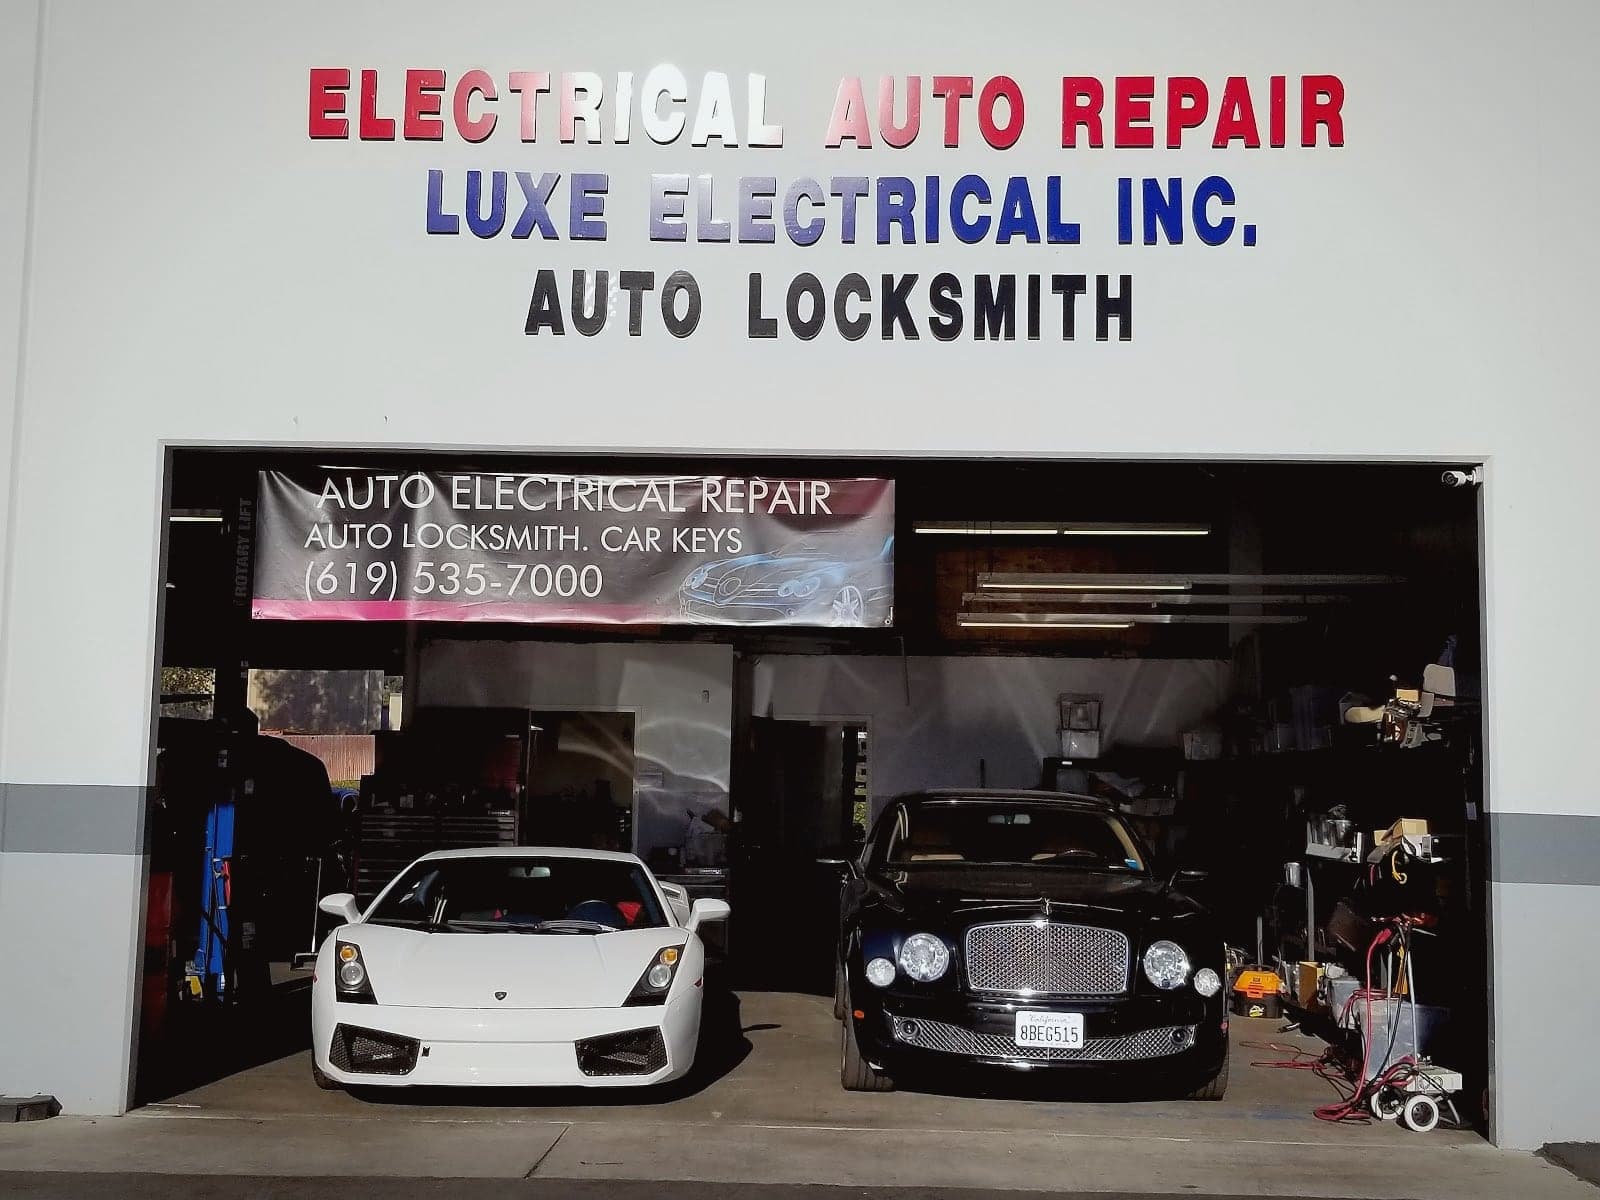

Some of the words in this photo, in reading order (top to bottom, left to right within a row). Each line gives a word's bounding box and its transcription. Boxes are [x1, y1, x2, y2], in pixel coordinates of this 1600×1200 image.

[309, 64, 784, 148] ELECTRICAL
[825, 75, 1025, 149] AUTO
[1062, 75, 1346, 149] REPAIR
[426, 170, 609, 240] LUXE
[650, 174, 1081, 246] ELECTRICAL
[1118, 175, 1258, 247] INC.
[524, 269, 702, 339] AUTO
[748, 272, 1134, 342] LOCKSMITH
[315, 474, 436, 510] AUTO
[451, 475, 686, 513] ELECTRICAL
[701, 478, 834, 515] REPAIR
[304, 523, 393, 550] AUTO
[402, 523, 589, 552] LOCKSMITH.
[601, 526, 664, 552] CAR
[672, 527, 743, 554] KEYS
[304, 560, 398, 603] (619)
[413, 563, 603, 598] 535-7000
[1020, 1025, 1079, 1043] 8BEG515
